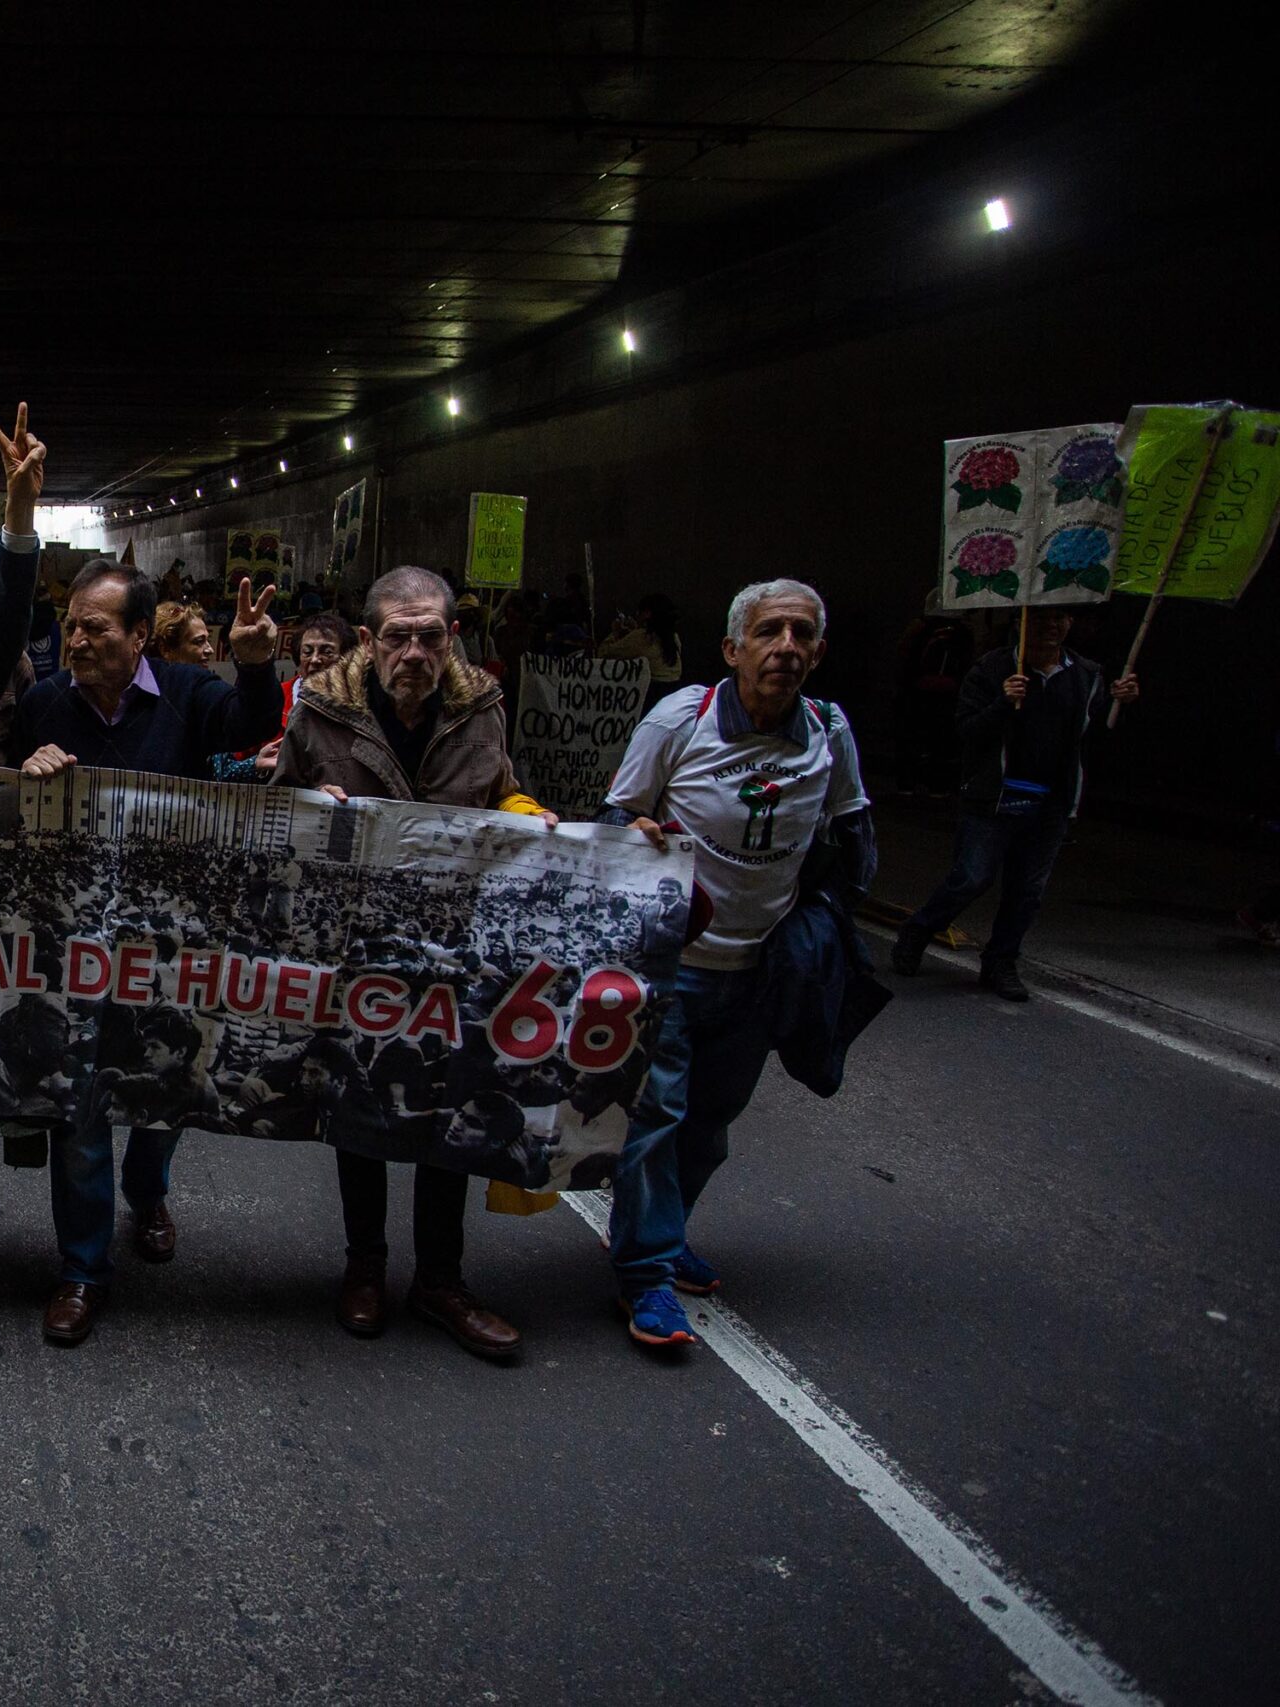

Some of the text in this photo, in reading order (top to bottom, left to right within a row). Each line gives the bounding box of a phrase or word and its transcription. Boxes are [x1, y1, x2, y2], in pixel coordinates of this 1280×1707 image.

[1127, 471, 1157, 502] DE
[1136, 456, 1199, 582] VIOLENCIA
[1195, 467, 1260, 571] PUEBLOS
[525, 654, 643, 683] HOMBRO CON
[558, 683, 640, 714] HOMBRO
[522, 708, 575, 745] CODO
[516, 746, 600, 767] ATLAPULCO
[528, 765, 609, 788] ATLAPULCO
[712, 763, 742, 782] ALTO
[745, 762, 759, 773] AL
[537, 785, 609, 808] ATLAPUL
[702, 835, 716, 849] DE
[713, 843, 764, 865] NUESTROS
[66, 941, 154, 1003] DE
[176, 950, 462, 1045] HUELGA
[490, 959, 643, 1072] 68
